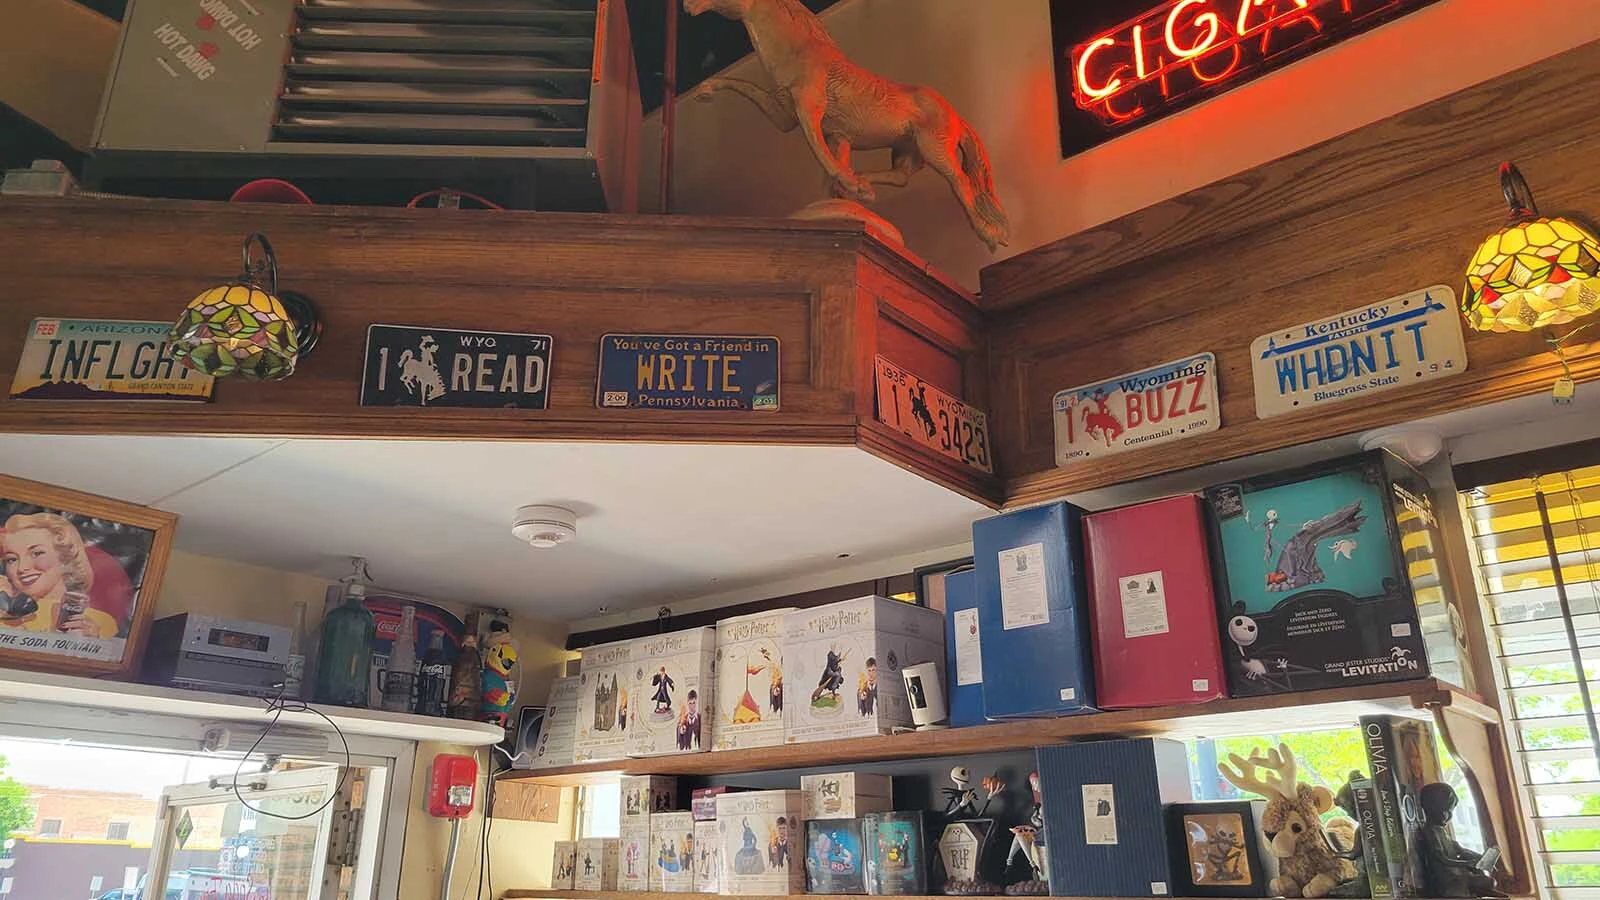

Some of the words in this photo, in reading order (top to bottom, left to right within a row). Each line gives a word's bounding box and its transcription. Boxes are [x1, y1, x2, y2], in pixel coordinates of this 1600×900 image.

[153, 23, 187, 51] HOT
[175, 45, 216, 81] DAWG
[1304, 306, 1390, 338] Kentucky
[1328, 325, 1369, 341] FAYETTE
[460, 336, 497, 348] WYO
[530, 340, 547, 350] 71
[664, 339, 689, 351] Got
[694, 343, 701, 351] a
[705, 339, 752, 352] Friend
[756, 341, 769, 352] in
[378, 347, 389, 391] 1
[451, 353, 545, 393] READ
[637, 353, 741, 392] WRITE
[1119, 361, 1207, 394] Wyoming
[638, 394, 738, 409] Pennsylvania
[1313, 381, 1368, 402] Bluegrass
[1369, 374, 1400, 389] State
[1125, 375, 1207, 430] BUZZ
[939, 409, 988, 466] 3423
[1124, 427, 1174, 446] Centennial
[20, 637, 47, 648] SODA
[52, 640, 102, 654] FOUNTAIN
[1342, 657, 1418, 677] LEVITATION
[1366, 723, 1389, 775] OLIVIA
[1362, 810, 1376, 840] OLIVIA
[950, 849, 970, 870] RIP
